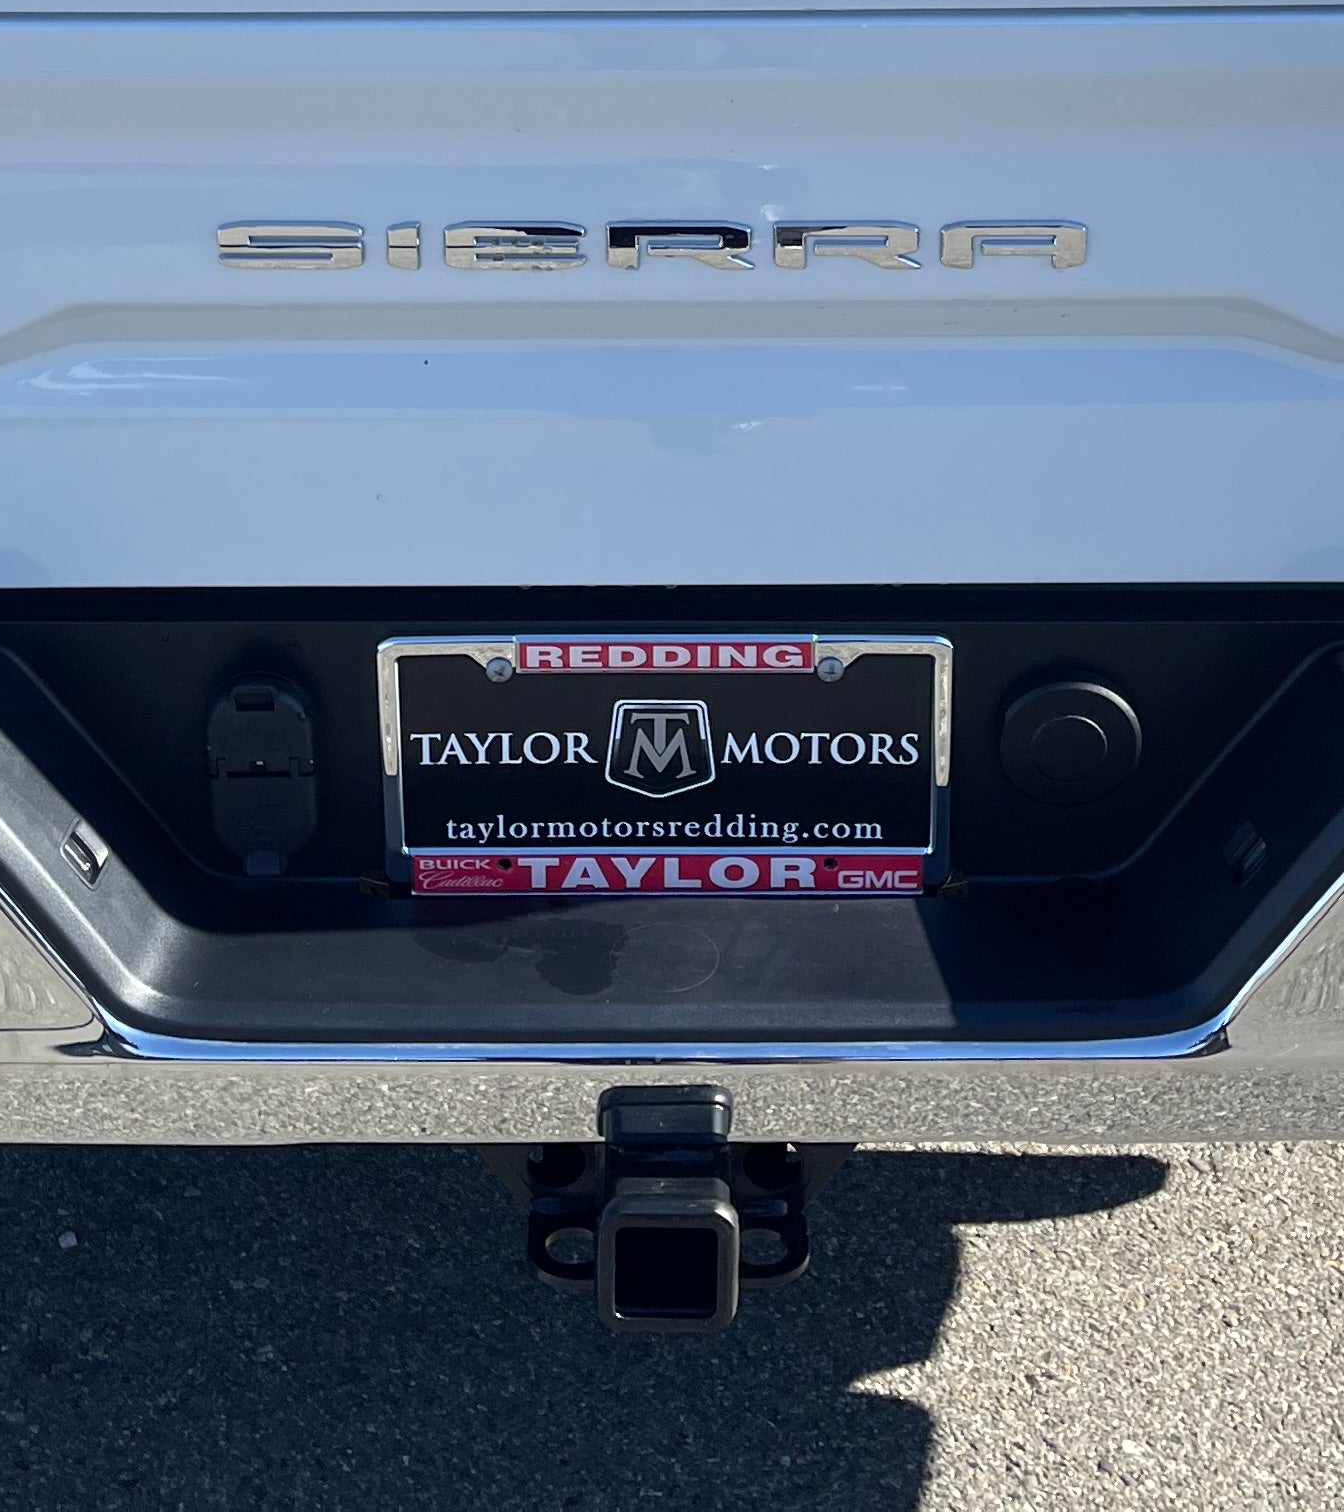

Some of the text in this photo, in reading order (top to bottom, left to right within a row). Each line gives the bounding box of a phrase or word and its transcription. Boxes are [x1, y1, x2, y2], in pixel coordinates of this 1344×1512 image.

[216, 219, 1088, 271] SIERRA
[526, 645, 804, 668] REDDING
[410, 732, 919, 765] TAYLOR MOTORS
[446, 814, 883, 843] taylormotorsredding.com
[419, 859, 491, 870] BUICK
[517, 857, 816, 888] TAYLOR
[418, 870, 504, 890] Cadillac
[838, 870, 918, 889] GMC
